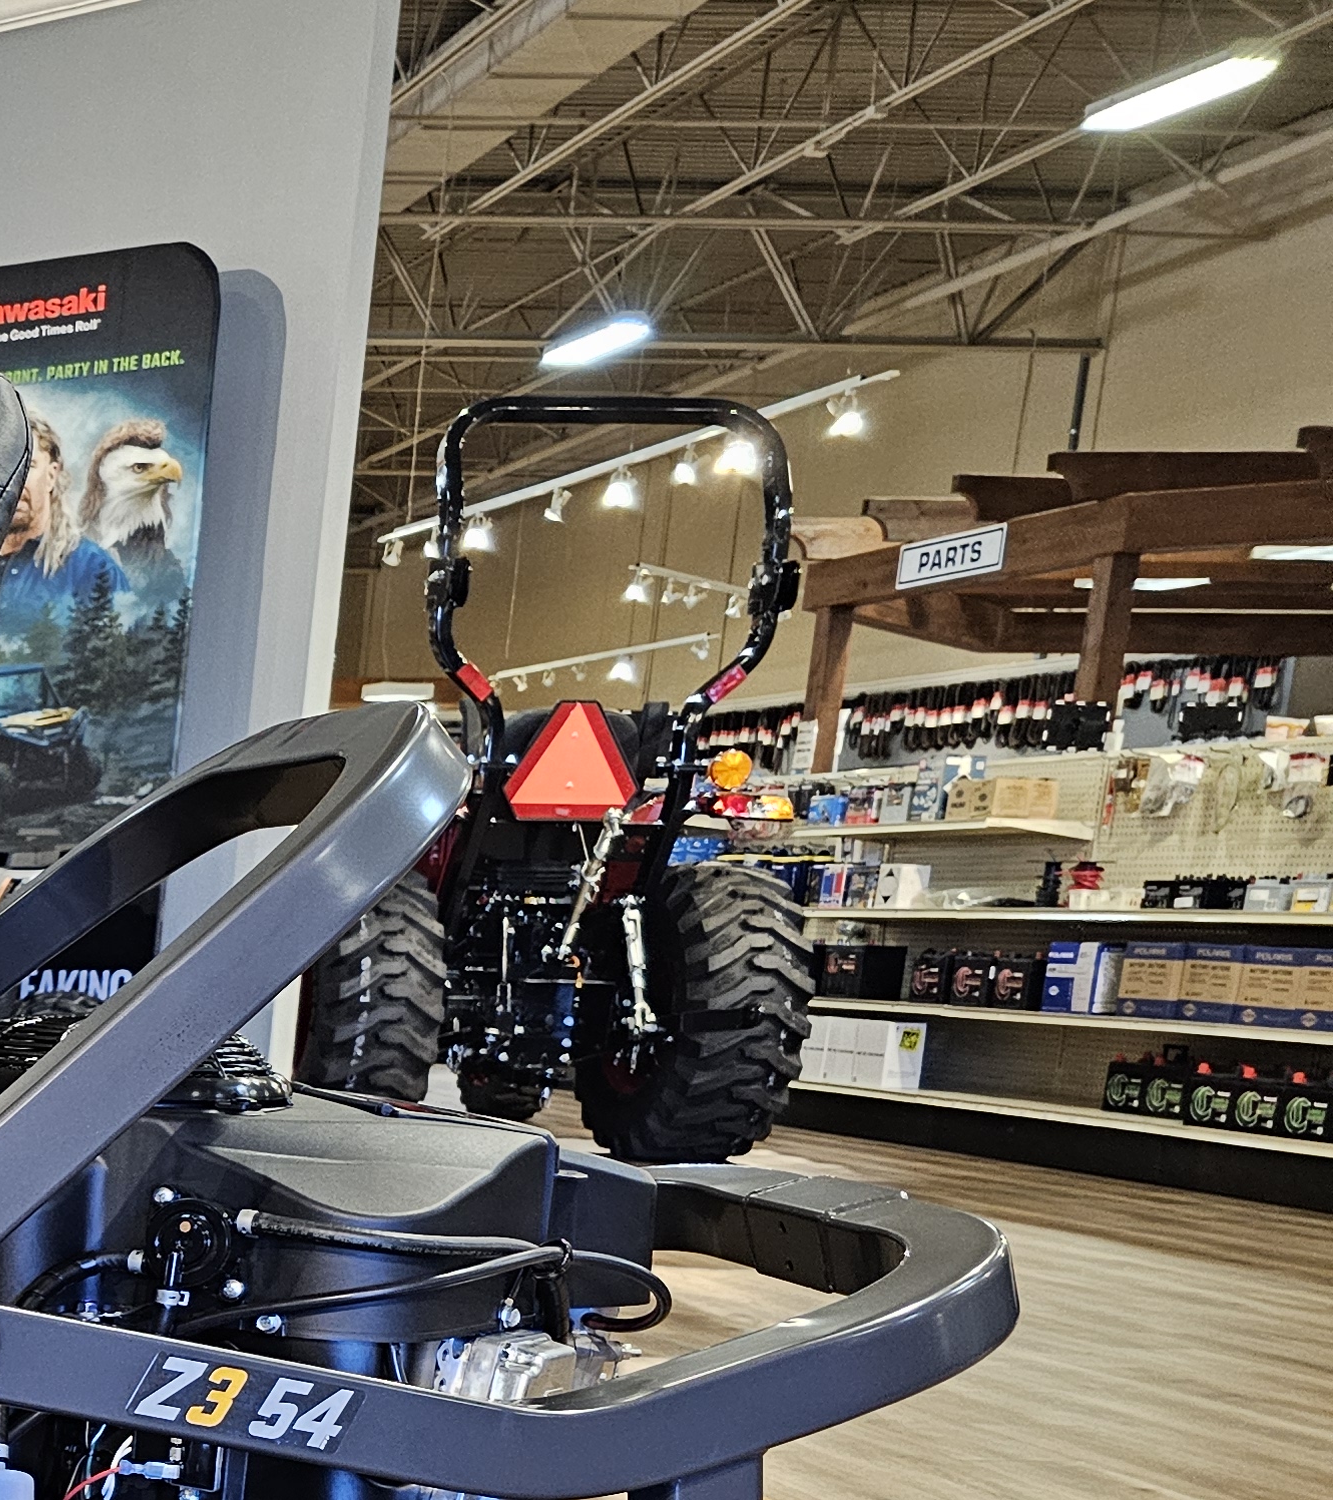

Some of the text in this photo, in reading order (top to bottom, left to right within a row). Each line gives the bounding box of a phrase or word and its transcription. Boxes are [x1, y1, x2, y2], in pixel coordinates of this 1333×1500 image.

[10, 326, 39, 341] Good
[41, 322, 74, 338] Times
[4, 367, 43, 385] RONT.
[46, 361, 90, 382] PARTY
[93, 357, 109, 375] IN
[112, 353, 139, 373] THE
[141, 350, 185, 370] BACK.
[917, 540, 982, 573] PARTS
[134, 1356, 354, 1449] Z3 54
